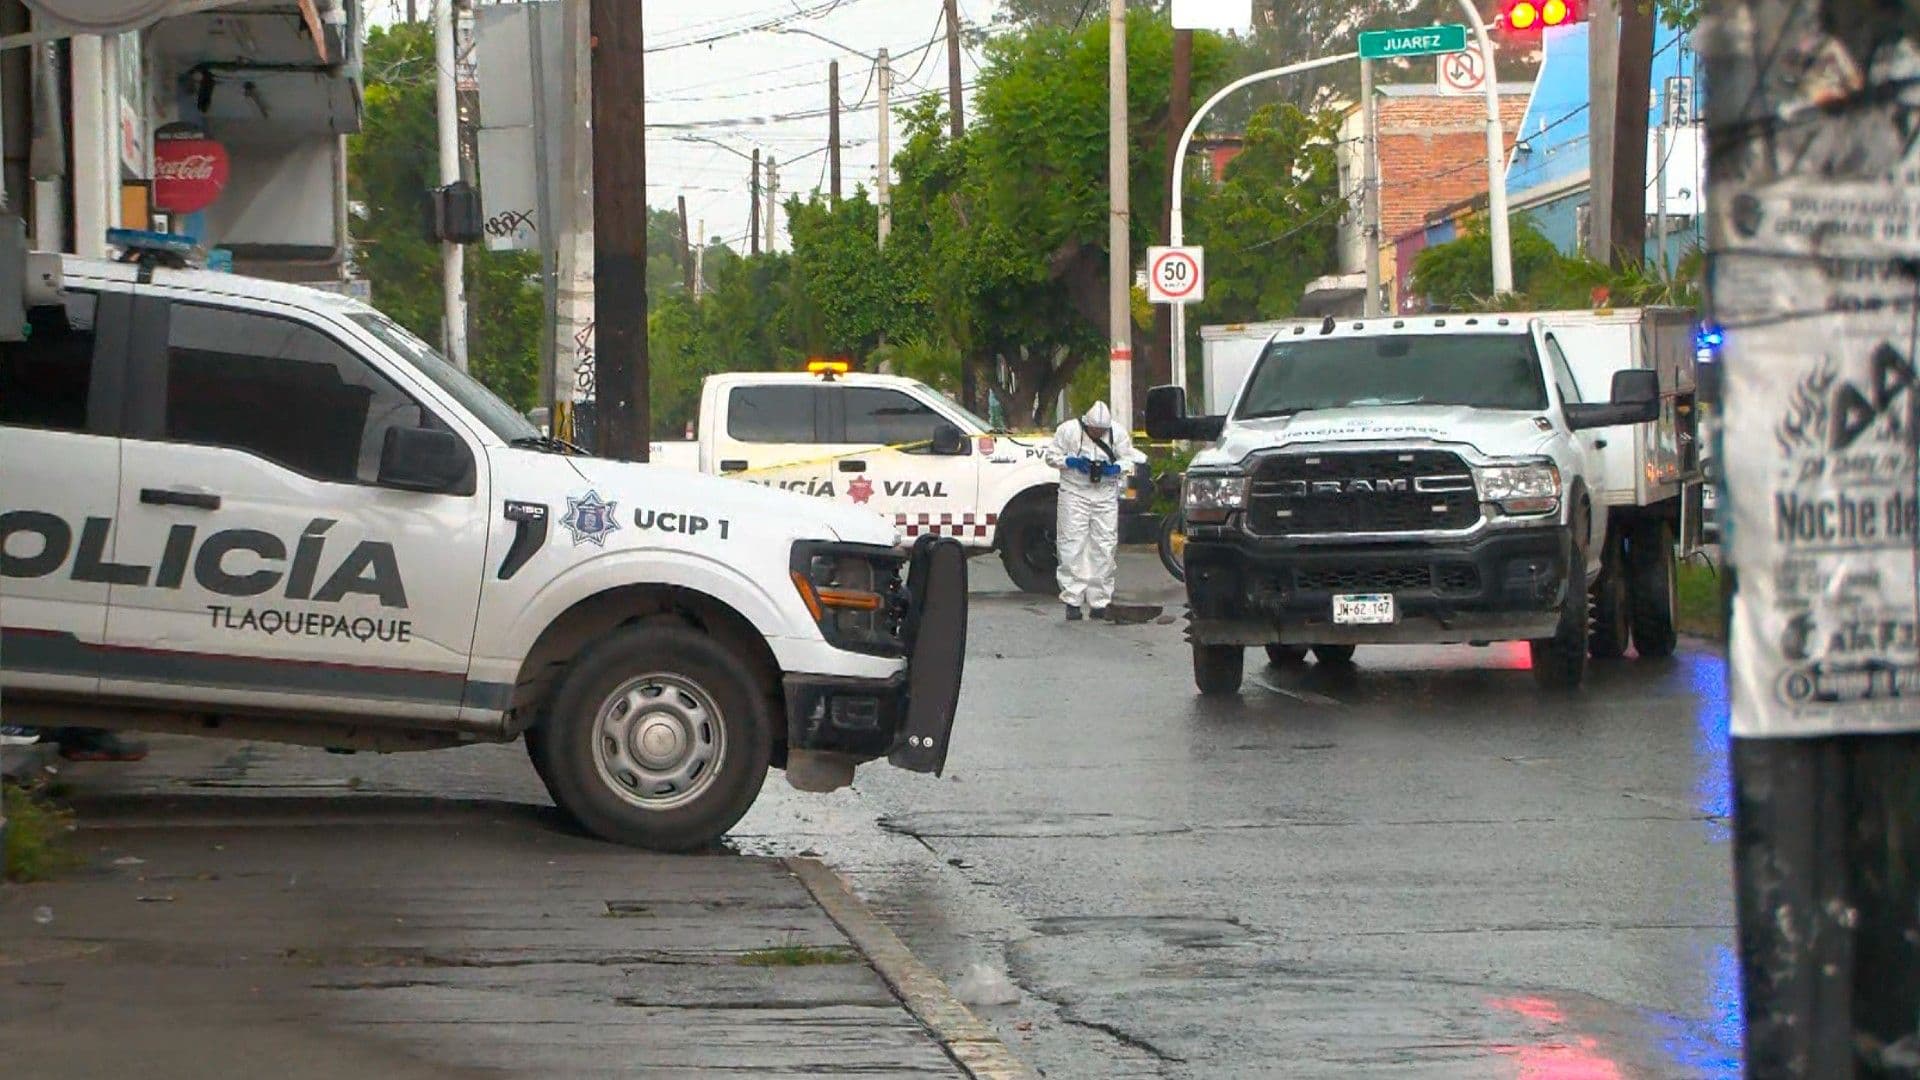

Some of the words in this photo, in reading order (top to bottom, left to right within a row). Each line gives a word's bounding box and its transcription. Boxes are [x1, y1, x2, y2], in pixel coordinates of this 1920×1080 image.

[1383, 35, 1441, 51] JUAREZ
[1164, 261, 1187, 281] 50
[883, 480, 948, 498] VIAL
[1312, 478, 1407, 493] RAM
[634, 507, 709, 535] UCIP
[718, 519, 729, 539] 1
[1775, 490, 1876, 544] Noche
[207, 605, 412, 643] TLAQUEPAQUE
